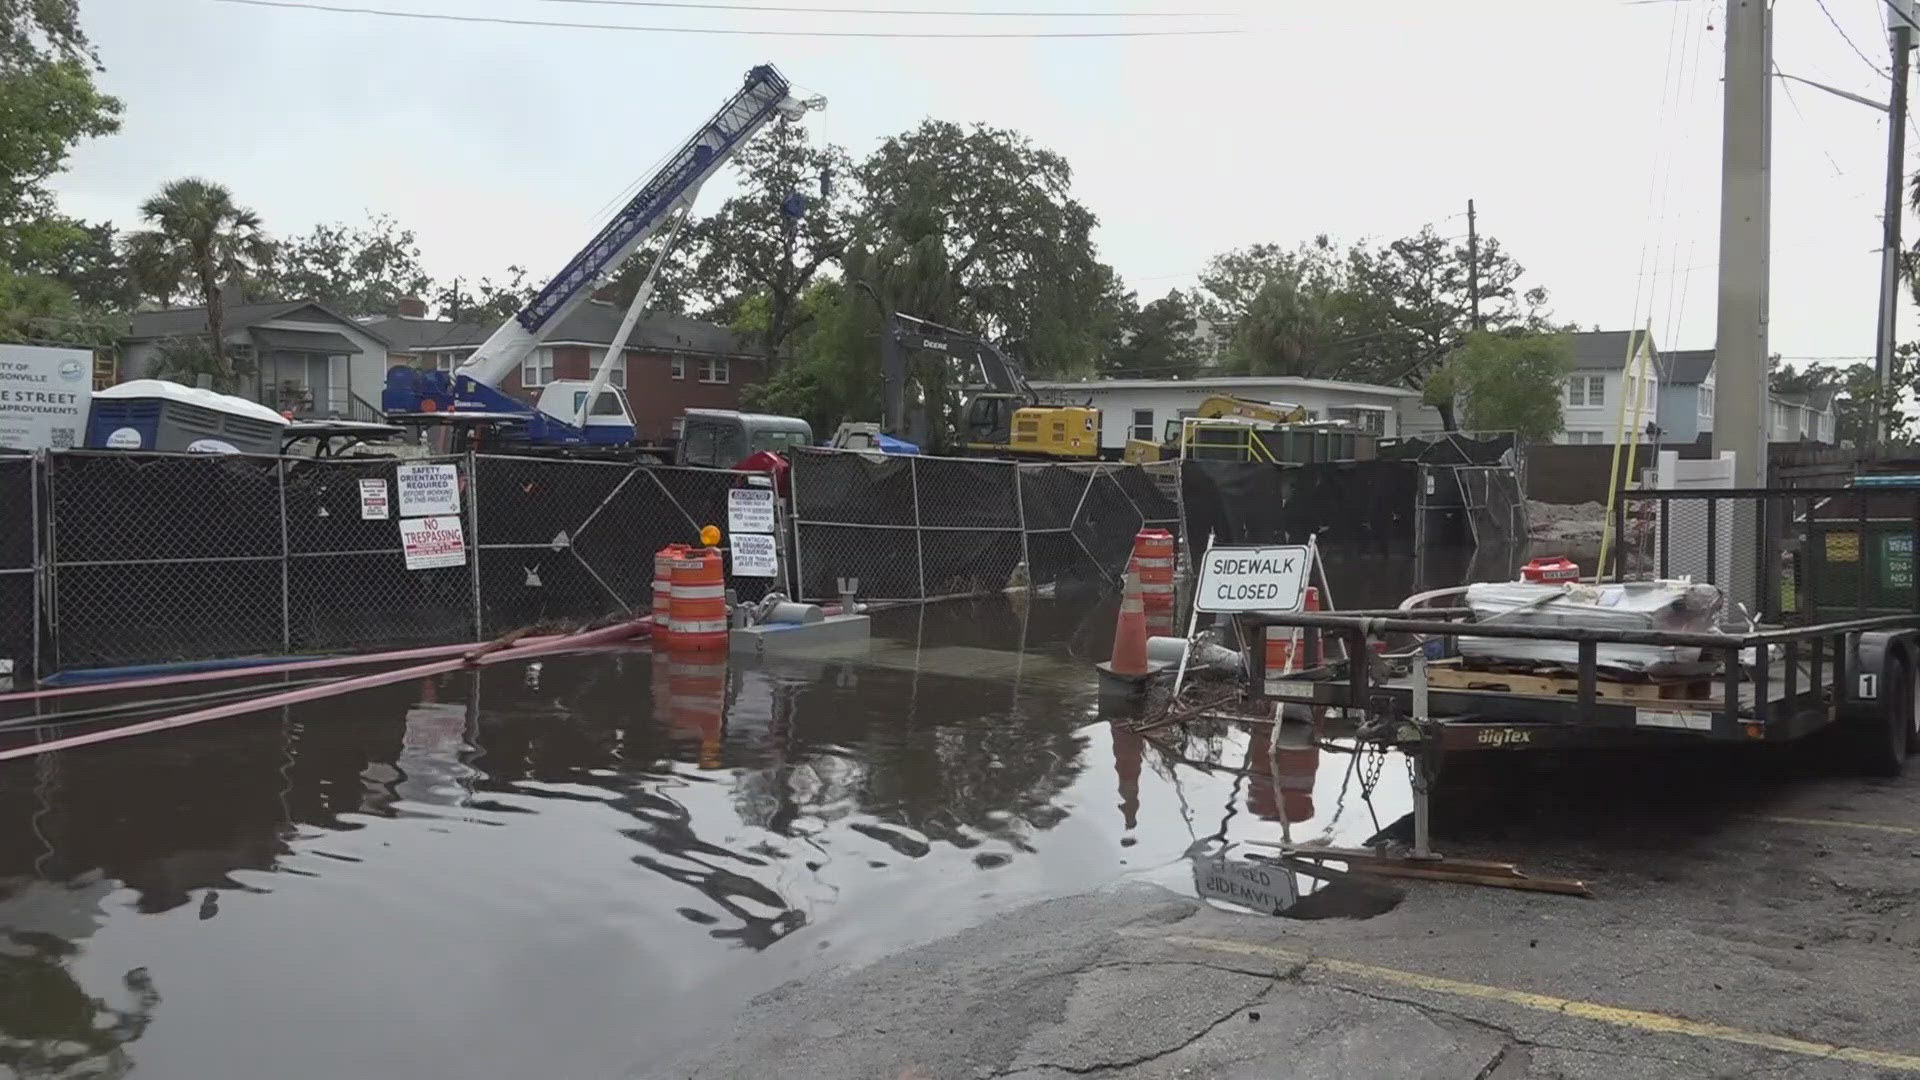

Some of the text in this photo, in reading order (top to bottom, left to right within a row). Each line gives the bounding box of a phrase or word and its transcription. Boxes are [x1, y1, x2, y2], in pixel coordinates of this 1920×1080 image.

[923, 339, 948, 350] DEERE
[15, 363, 29, 371] OF
[1, 390, 77, 404] E STREET
[400, 473, 454, 482] ORIENTATION
[406, 481, 448, 489] REQUIRED
[424, 518, 438, 530] NO
[404, 529, 461, 543] TRESPASSING
[1213, 558, 1295, 575] SIDEWALK
[1217, 583, 1278, 600] CLOSED
[1863, 675, 1874, 696] 1
